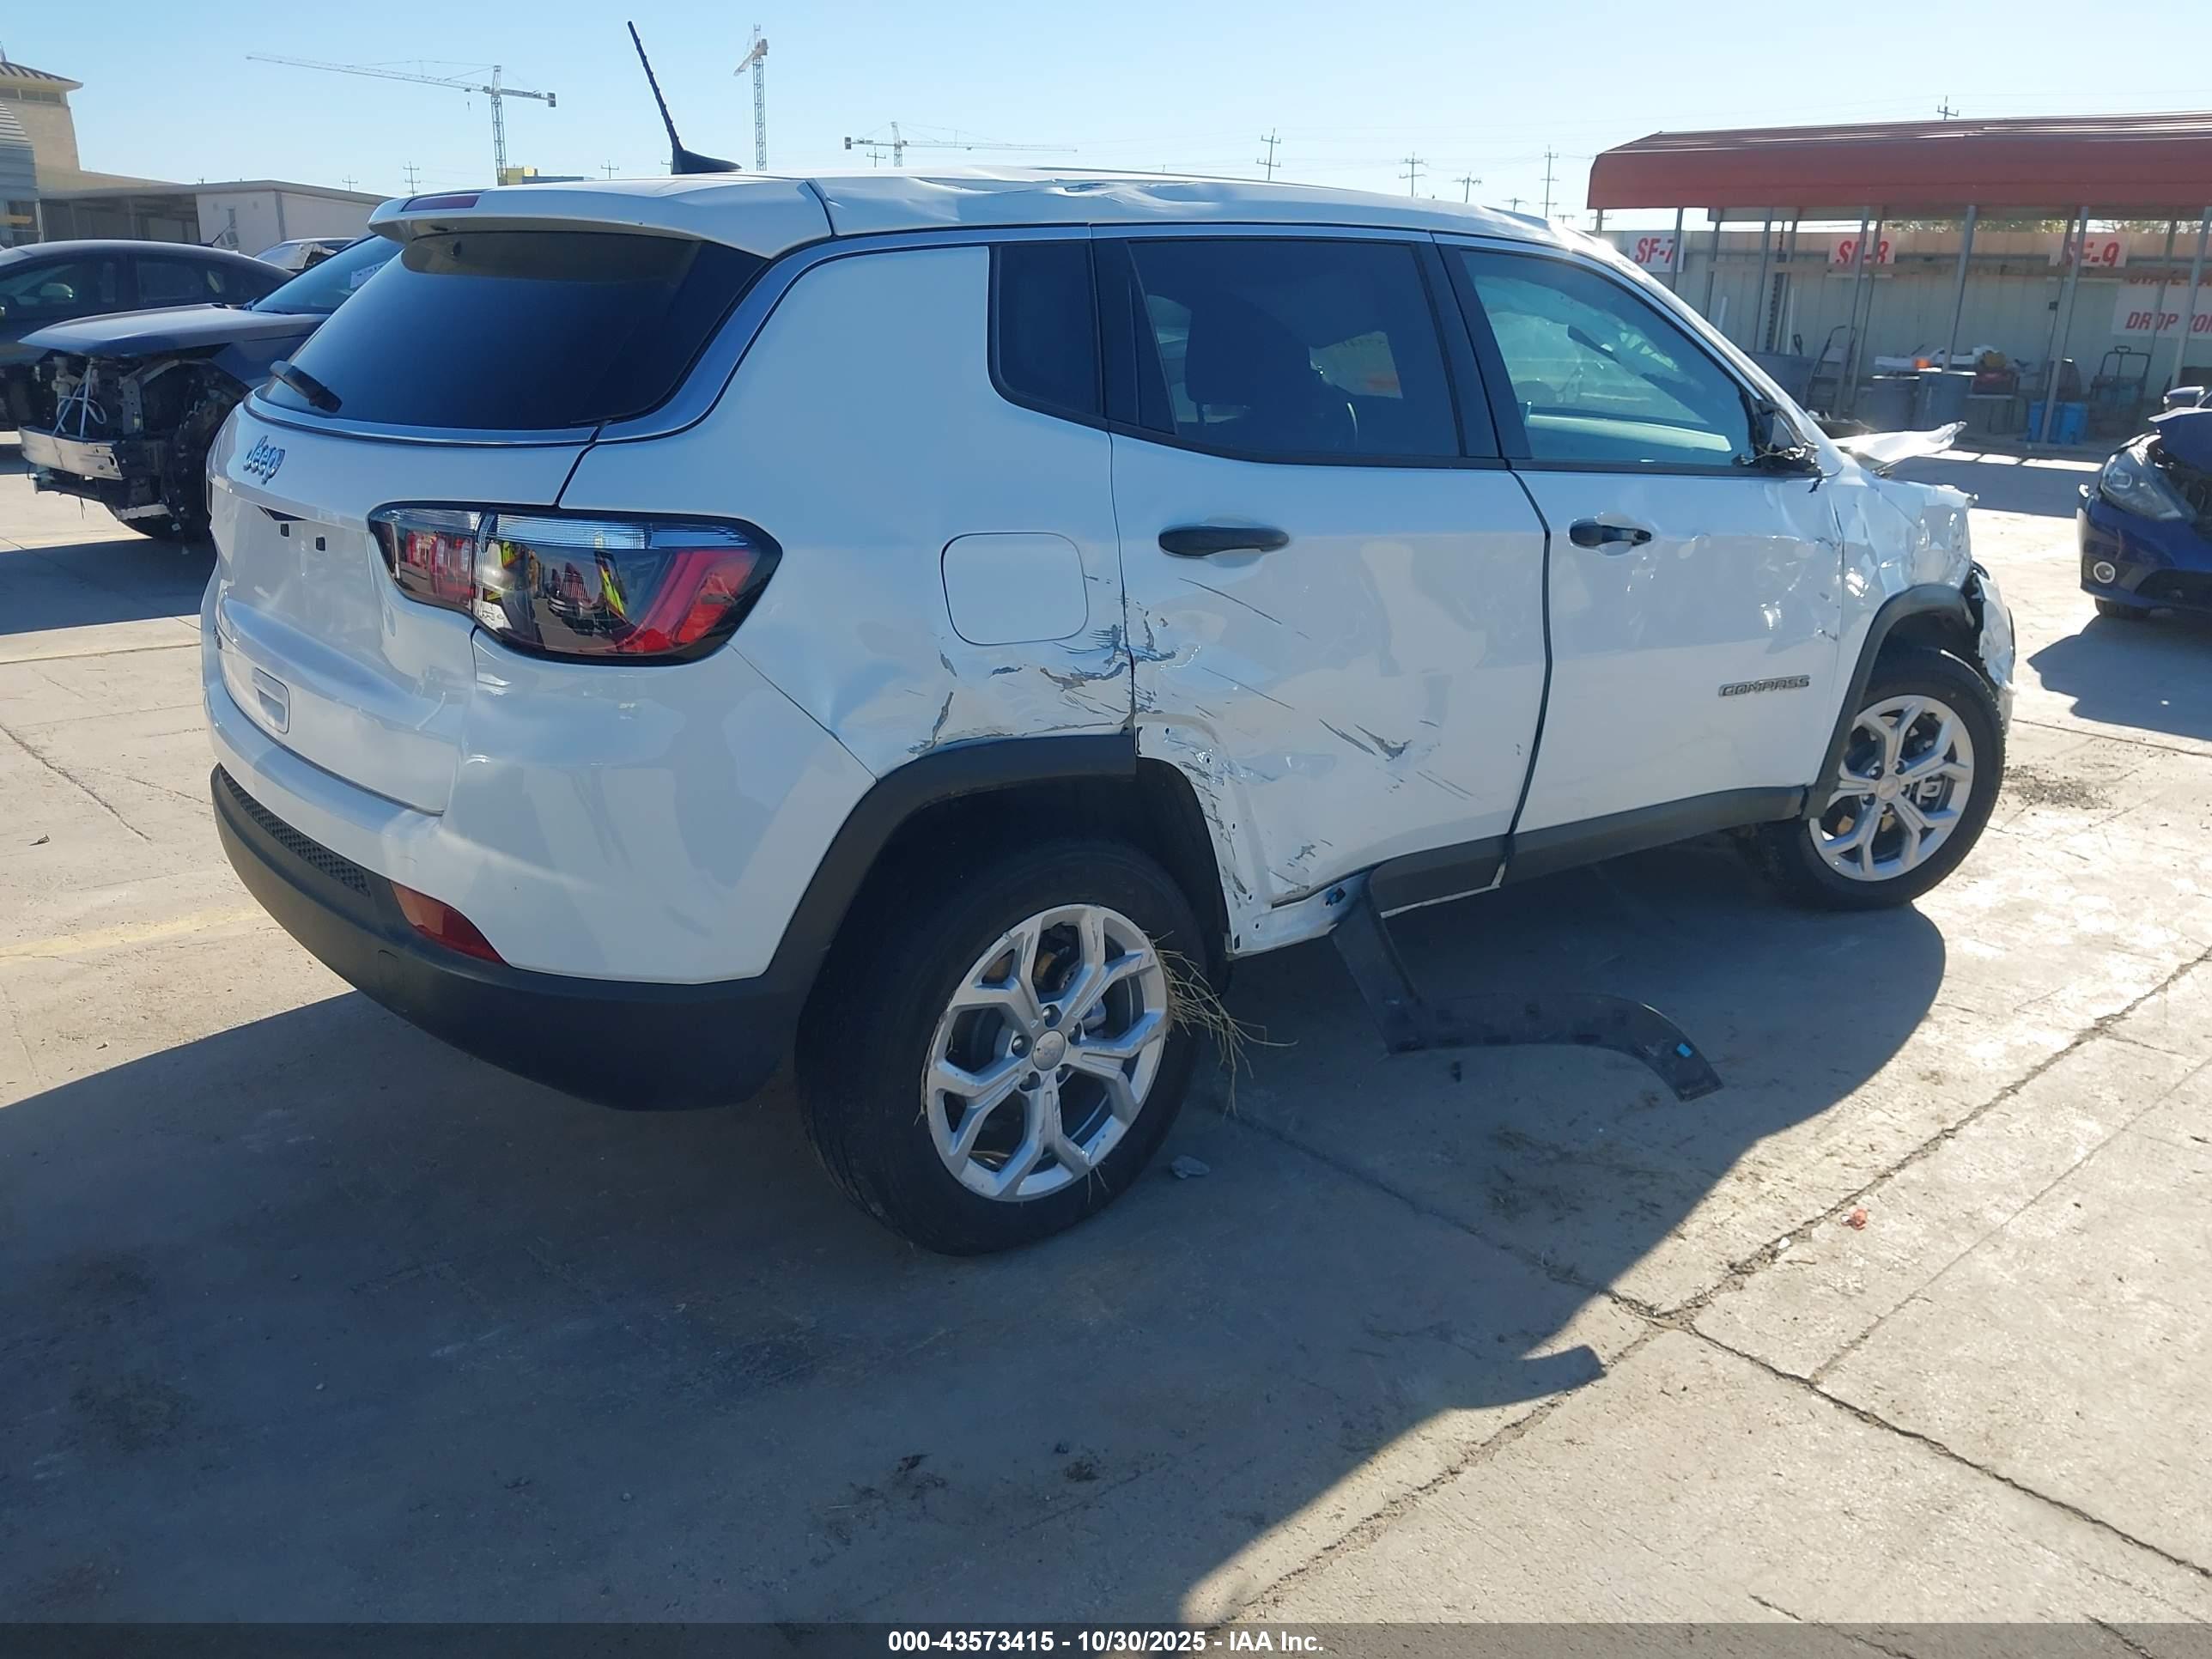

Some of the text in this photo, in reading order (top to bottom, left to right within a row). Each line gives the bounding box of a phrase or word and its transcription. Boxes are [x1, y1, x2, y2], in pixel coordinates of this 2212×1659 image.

[1634, 237, 1674, 264] SF-7
[242, 434, 286, 485] Jeep
[1719, 675, 1810, 697] COMPASS
